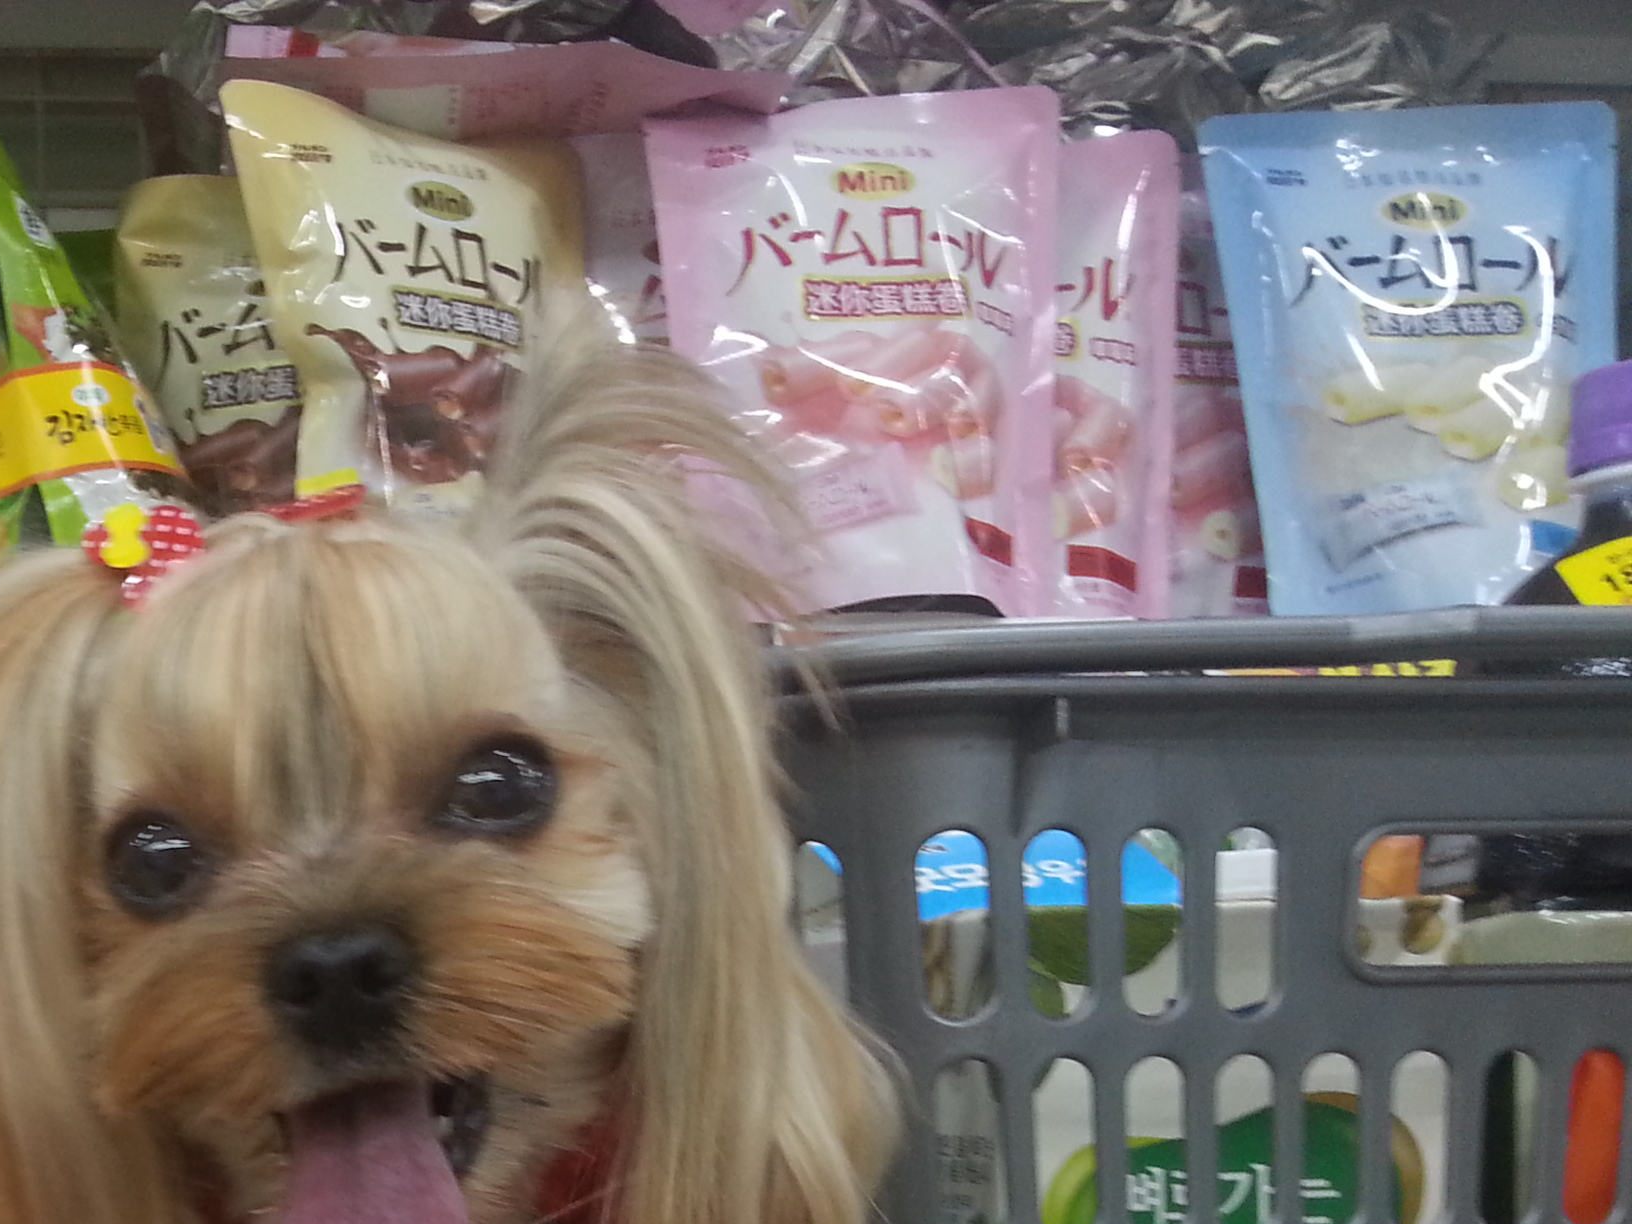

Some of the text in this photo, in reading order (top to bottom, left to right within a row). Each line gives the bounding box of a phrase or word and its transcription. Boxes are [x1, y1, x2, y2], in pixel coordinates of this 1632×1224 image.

[837, 169, 912, 195] Mini
[726, 206, 1008, 298] バームロール
